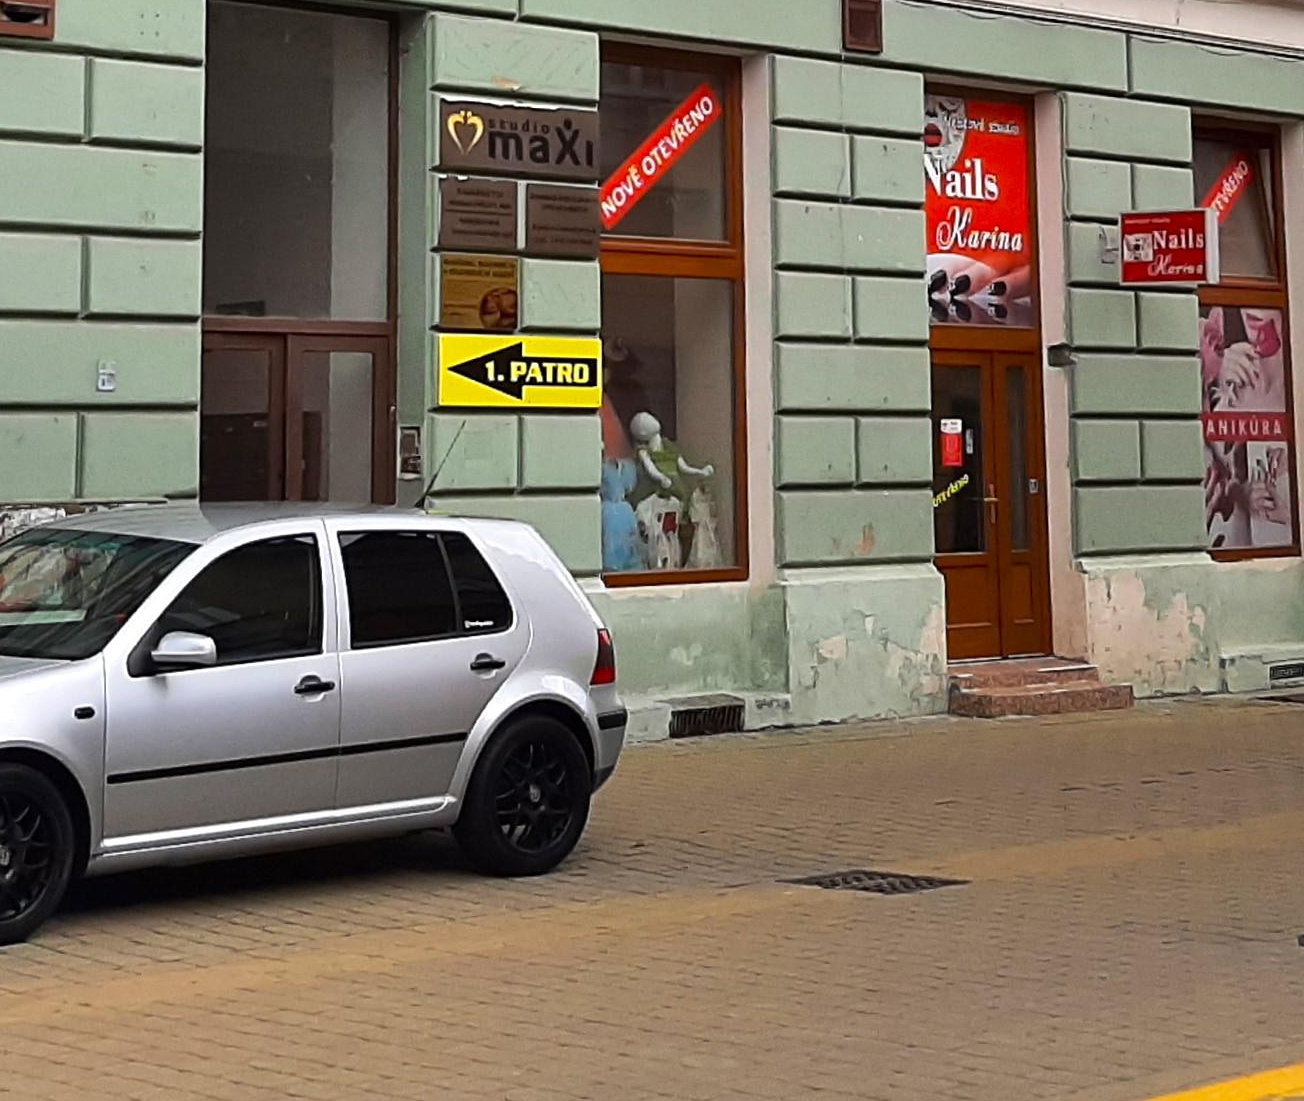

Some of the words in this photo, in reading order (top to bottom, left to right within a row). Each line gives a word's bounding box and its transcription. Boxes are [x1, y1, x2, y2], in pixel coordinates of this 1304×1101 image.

[488, 118, 549, 135] studio
[601, 163, 643, 219] NOVĚ
[642, 96, 713, 177] OTEVŘENO
[924, 153, 999, 201] Nails
[936, 206, 1023, 251] Karina
[1152, 228, 1204, 250] Nails
[1147, 253, 1203, 277] Karina
[486, 360, 504, 382] 1.
[510, 361, 589, 383] PATRO
[1206, 415, 1282, 437] ANIKÚRA
